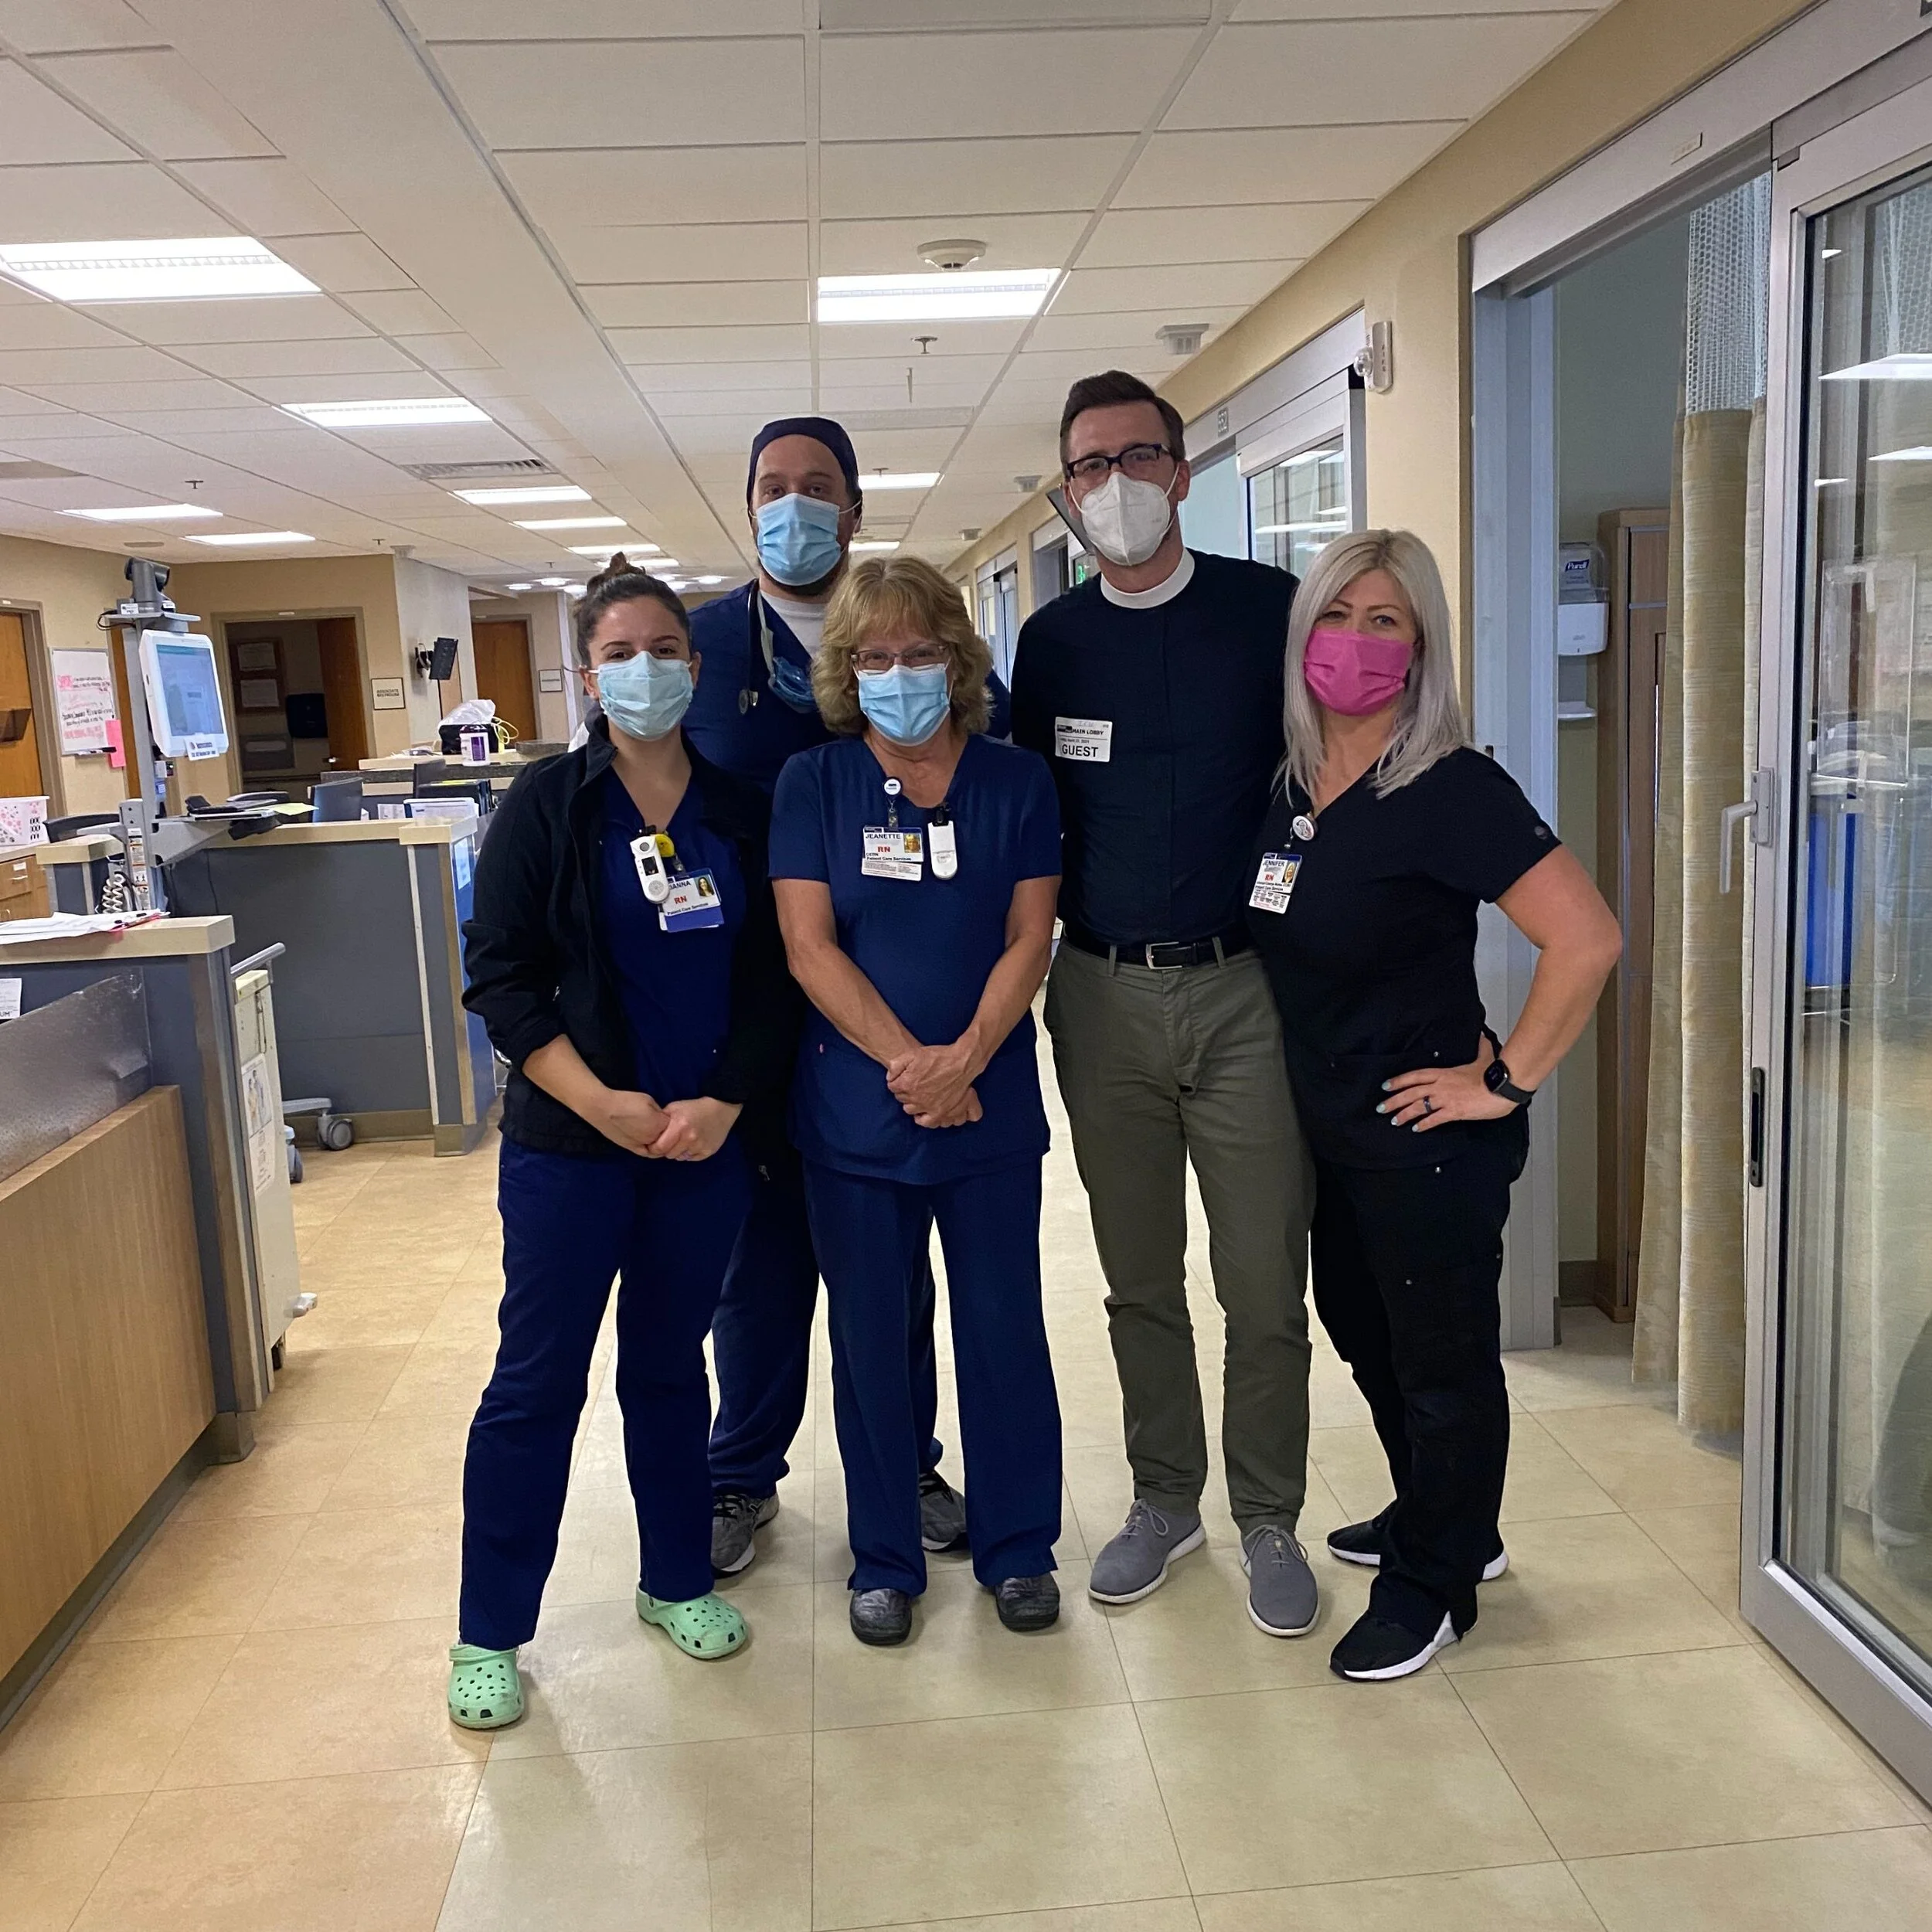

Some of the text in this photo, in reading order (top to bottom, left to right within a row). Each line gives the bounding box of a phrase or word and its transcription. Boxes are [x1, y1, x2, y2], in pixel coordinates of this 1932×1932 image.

[1062, 744, 1099, 757] GUEST
[669, 880, 691, 889] IANNA
[674, 896, 687, 904] RN
